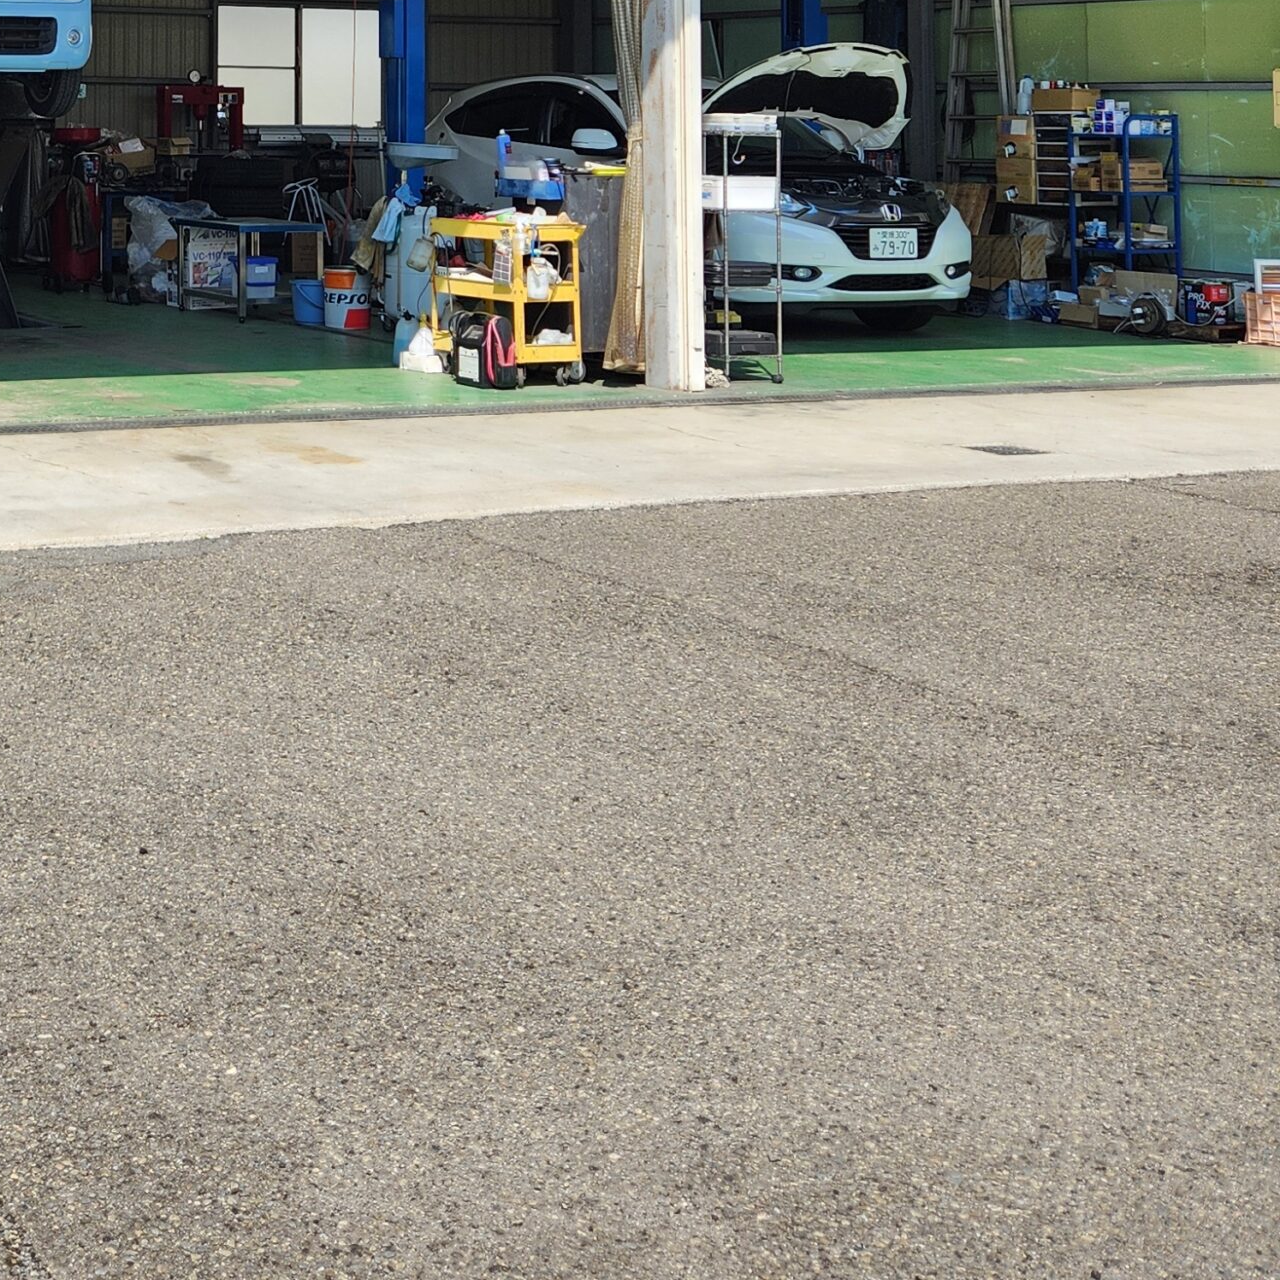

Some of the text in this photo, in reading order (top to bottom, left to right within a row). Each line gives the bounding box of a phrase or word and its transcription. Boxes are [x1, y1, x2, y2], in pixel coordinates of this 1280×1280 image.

[880, 241, 915, 256] 79-70
[1187, 292, 1206, 301] PRO
[1195, 300, 1212, 310] FIX
